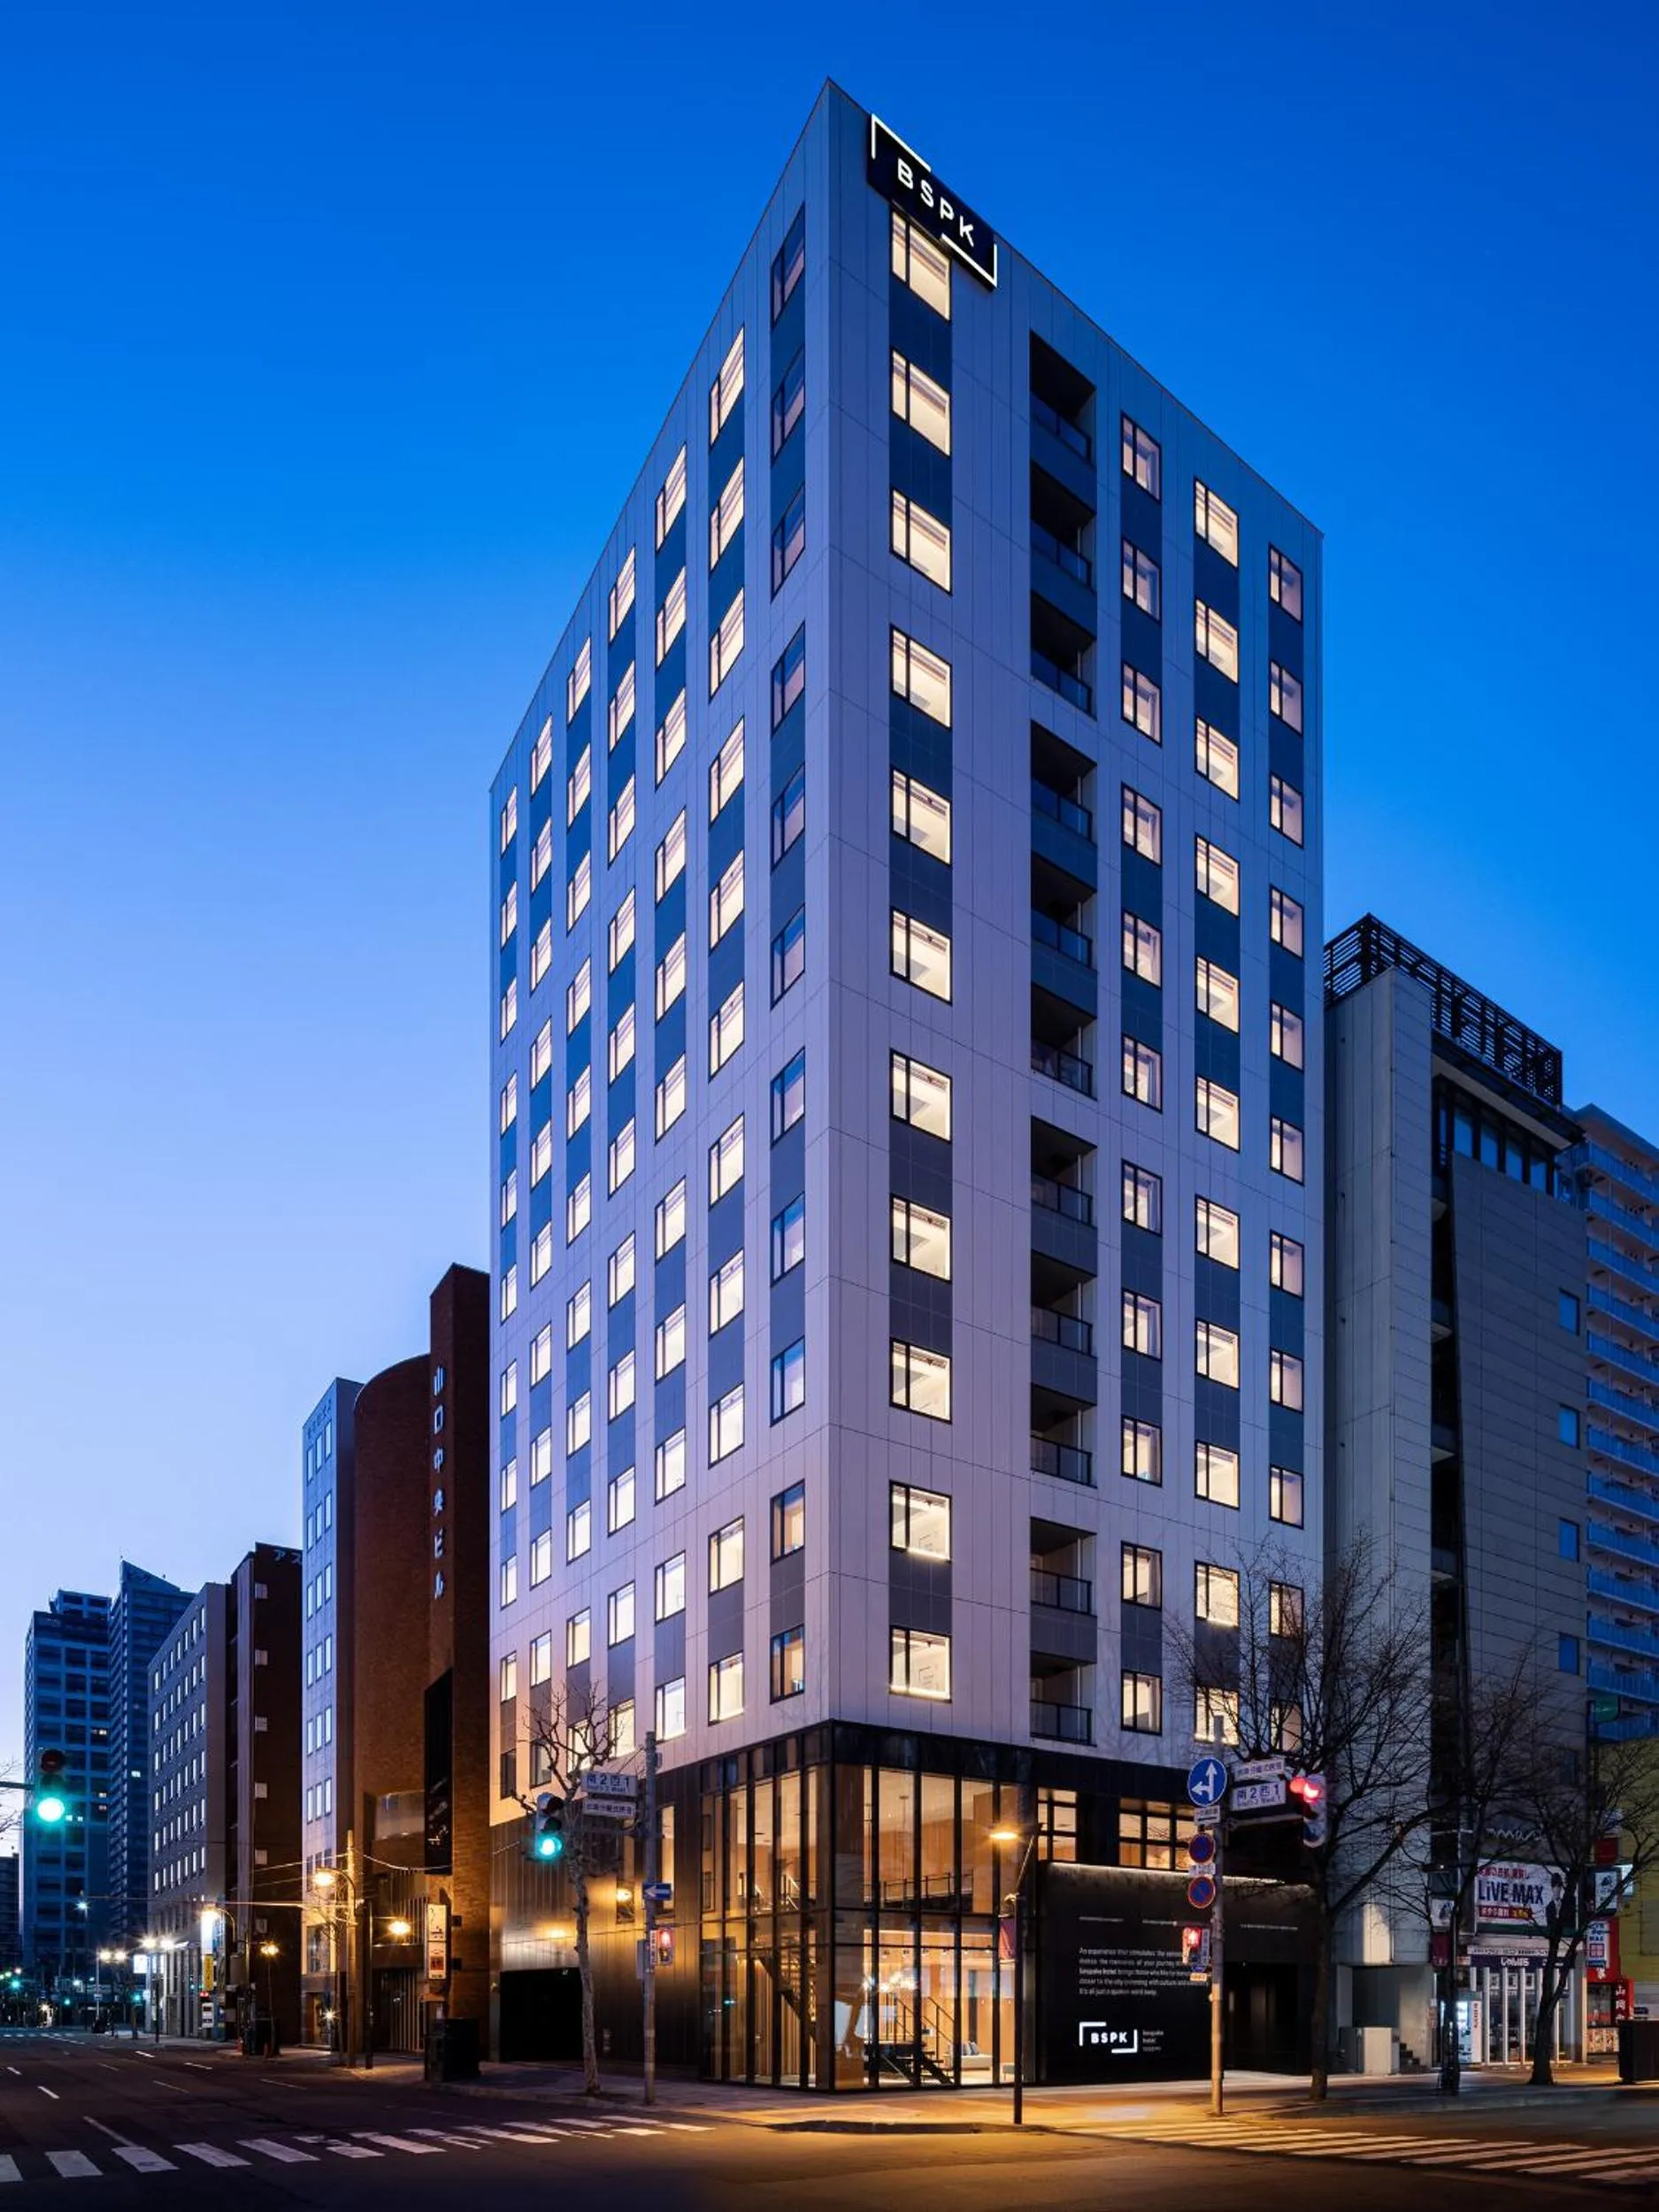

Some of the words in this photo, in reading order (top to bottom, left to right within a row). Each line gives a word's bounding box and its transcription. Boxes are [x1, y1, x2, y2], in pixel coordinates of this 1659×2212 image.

[897, 157, 975, 248] BSPK
[433, 1366, 444, 1601] 山口中央ビル
[1090, 2031, 1128, 2045] BSPK
